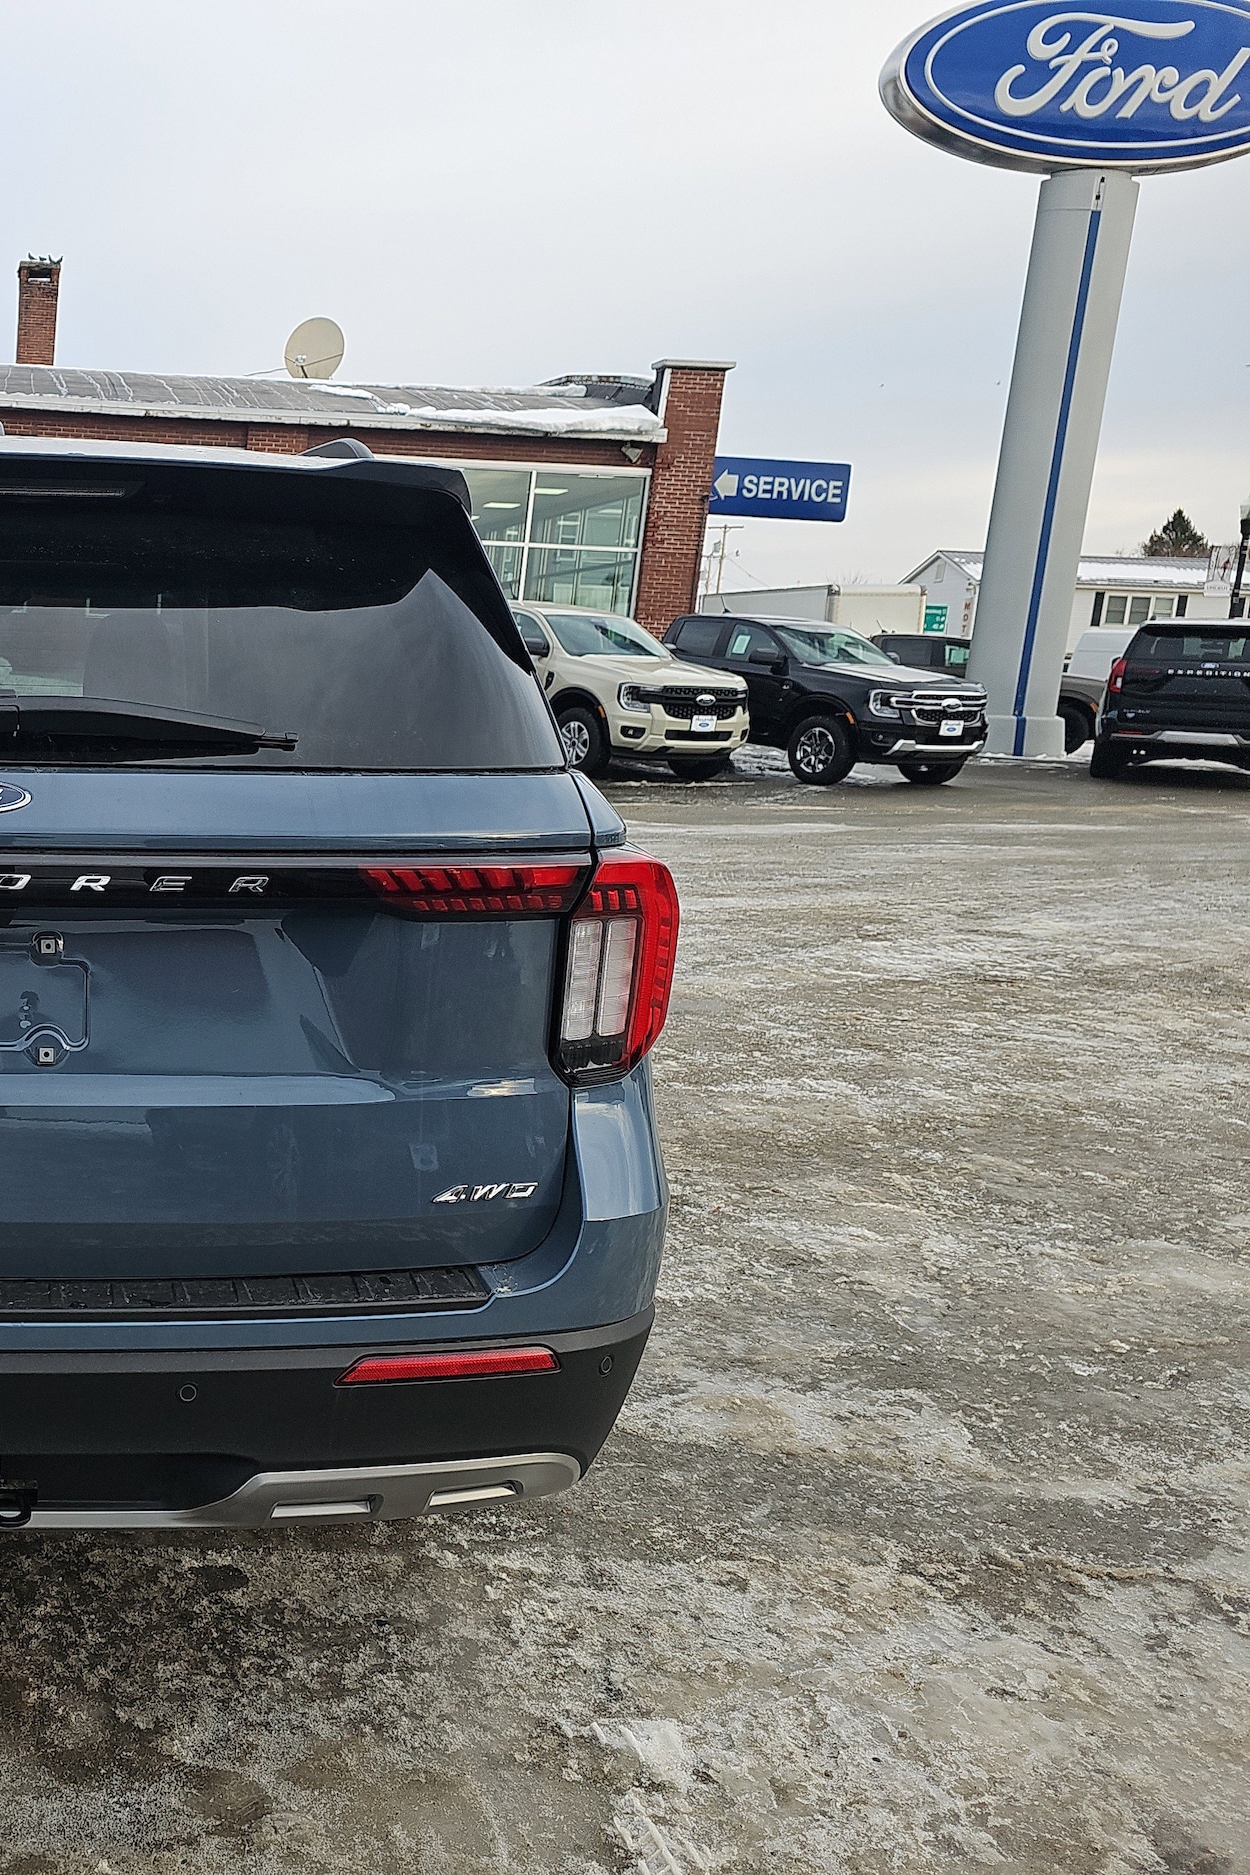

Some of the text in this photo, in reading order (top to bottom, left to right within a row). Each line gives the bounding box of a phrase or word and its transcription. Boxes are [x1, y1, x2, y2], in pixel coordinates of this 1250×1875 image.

[995, 12, 1241, 122] Ford
[741, 475, 843, 503] SERVICE
[432, 1182, 539, 1203] 4WD
